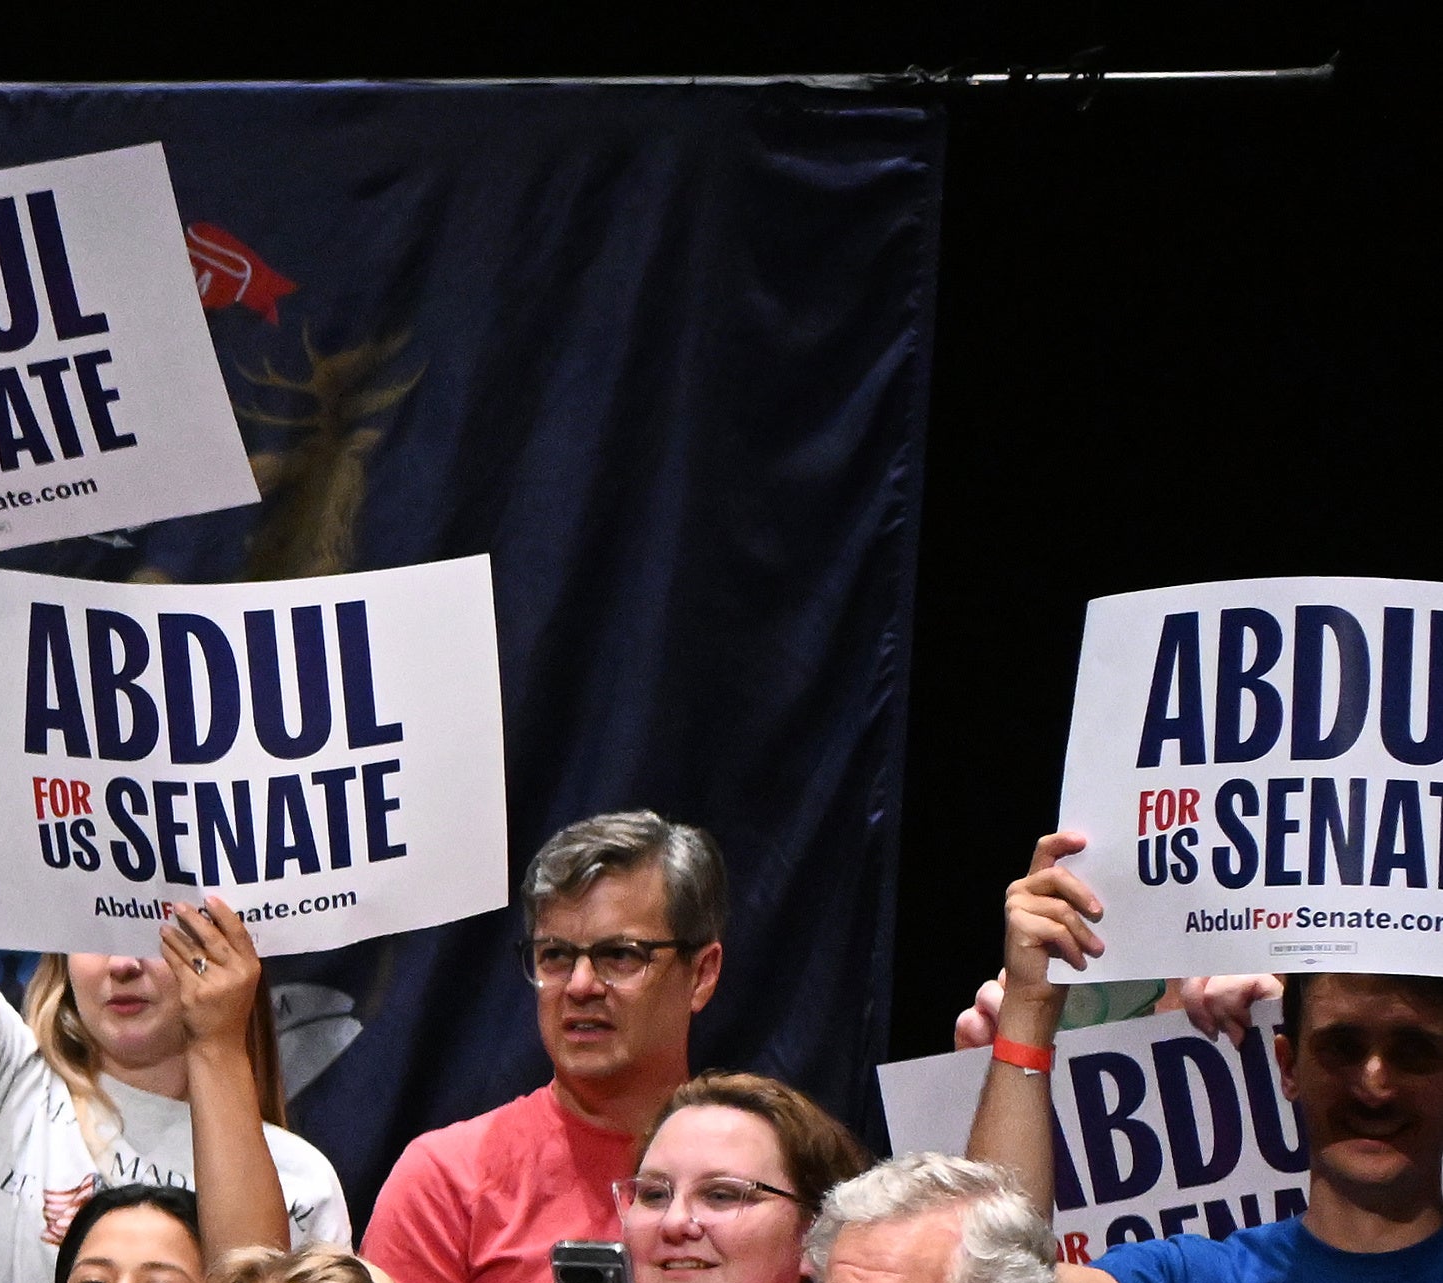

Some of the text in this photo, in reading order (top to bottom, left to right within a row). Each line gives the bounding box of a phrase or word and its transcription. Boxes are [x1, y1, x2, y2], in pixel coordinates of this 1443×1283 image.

[24, 599, 404, 765] ABDUL
[1136, 604, 1443, 769] ABDU
[32, 776, 92, 819] FOR
[39, 759, 407, 887] US SENATE
[1137, 778, 1443, 889] US SENA
[1138, 788, 1200, 835] FOR
[94, 889, 357, 925] AbdulFnate.com
[1053, 1024, 1311, 1212] BDU
